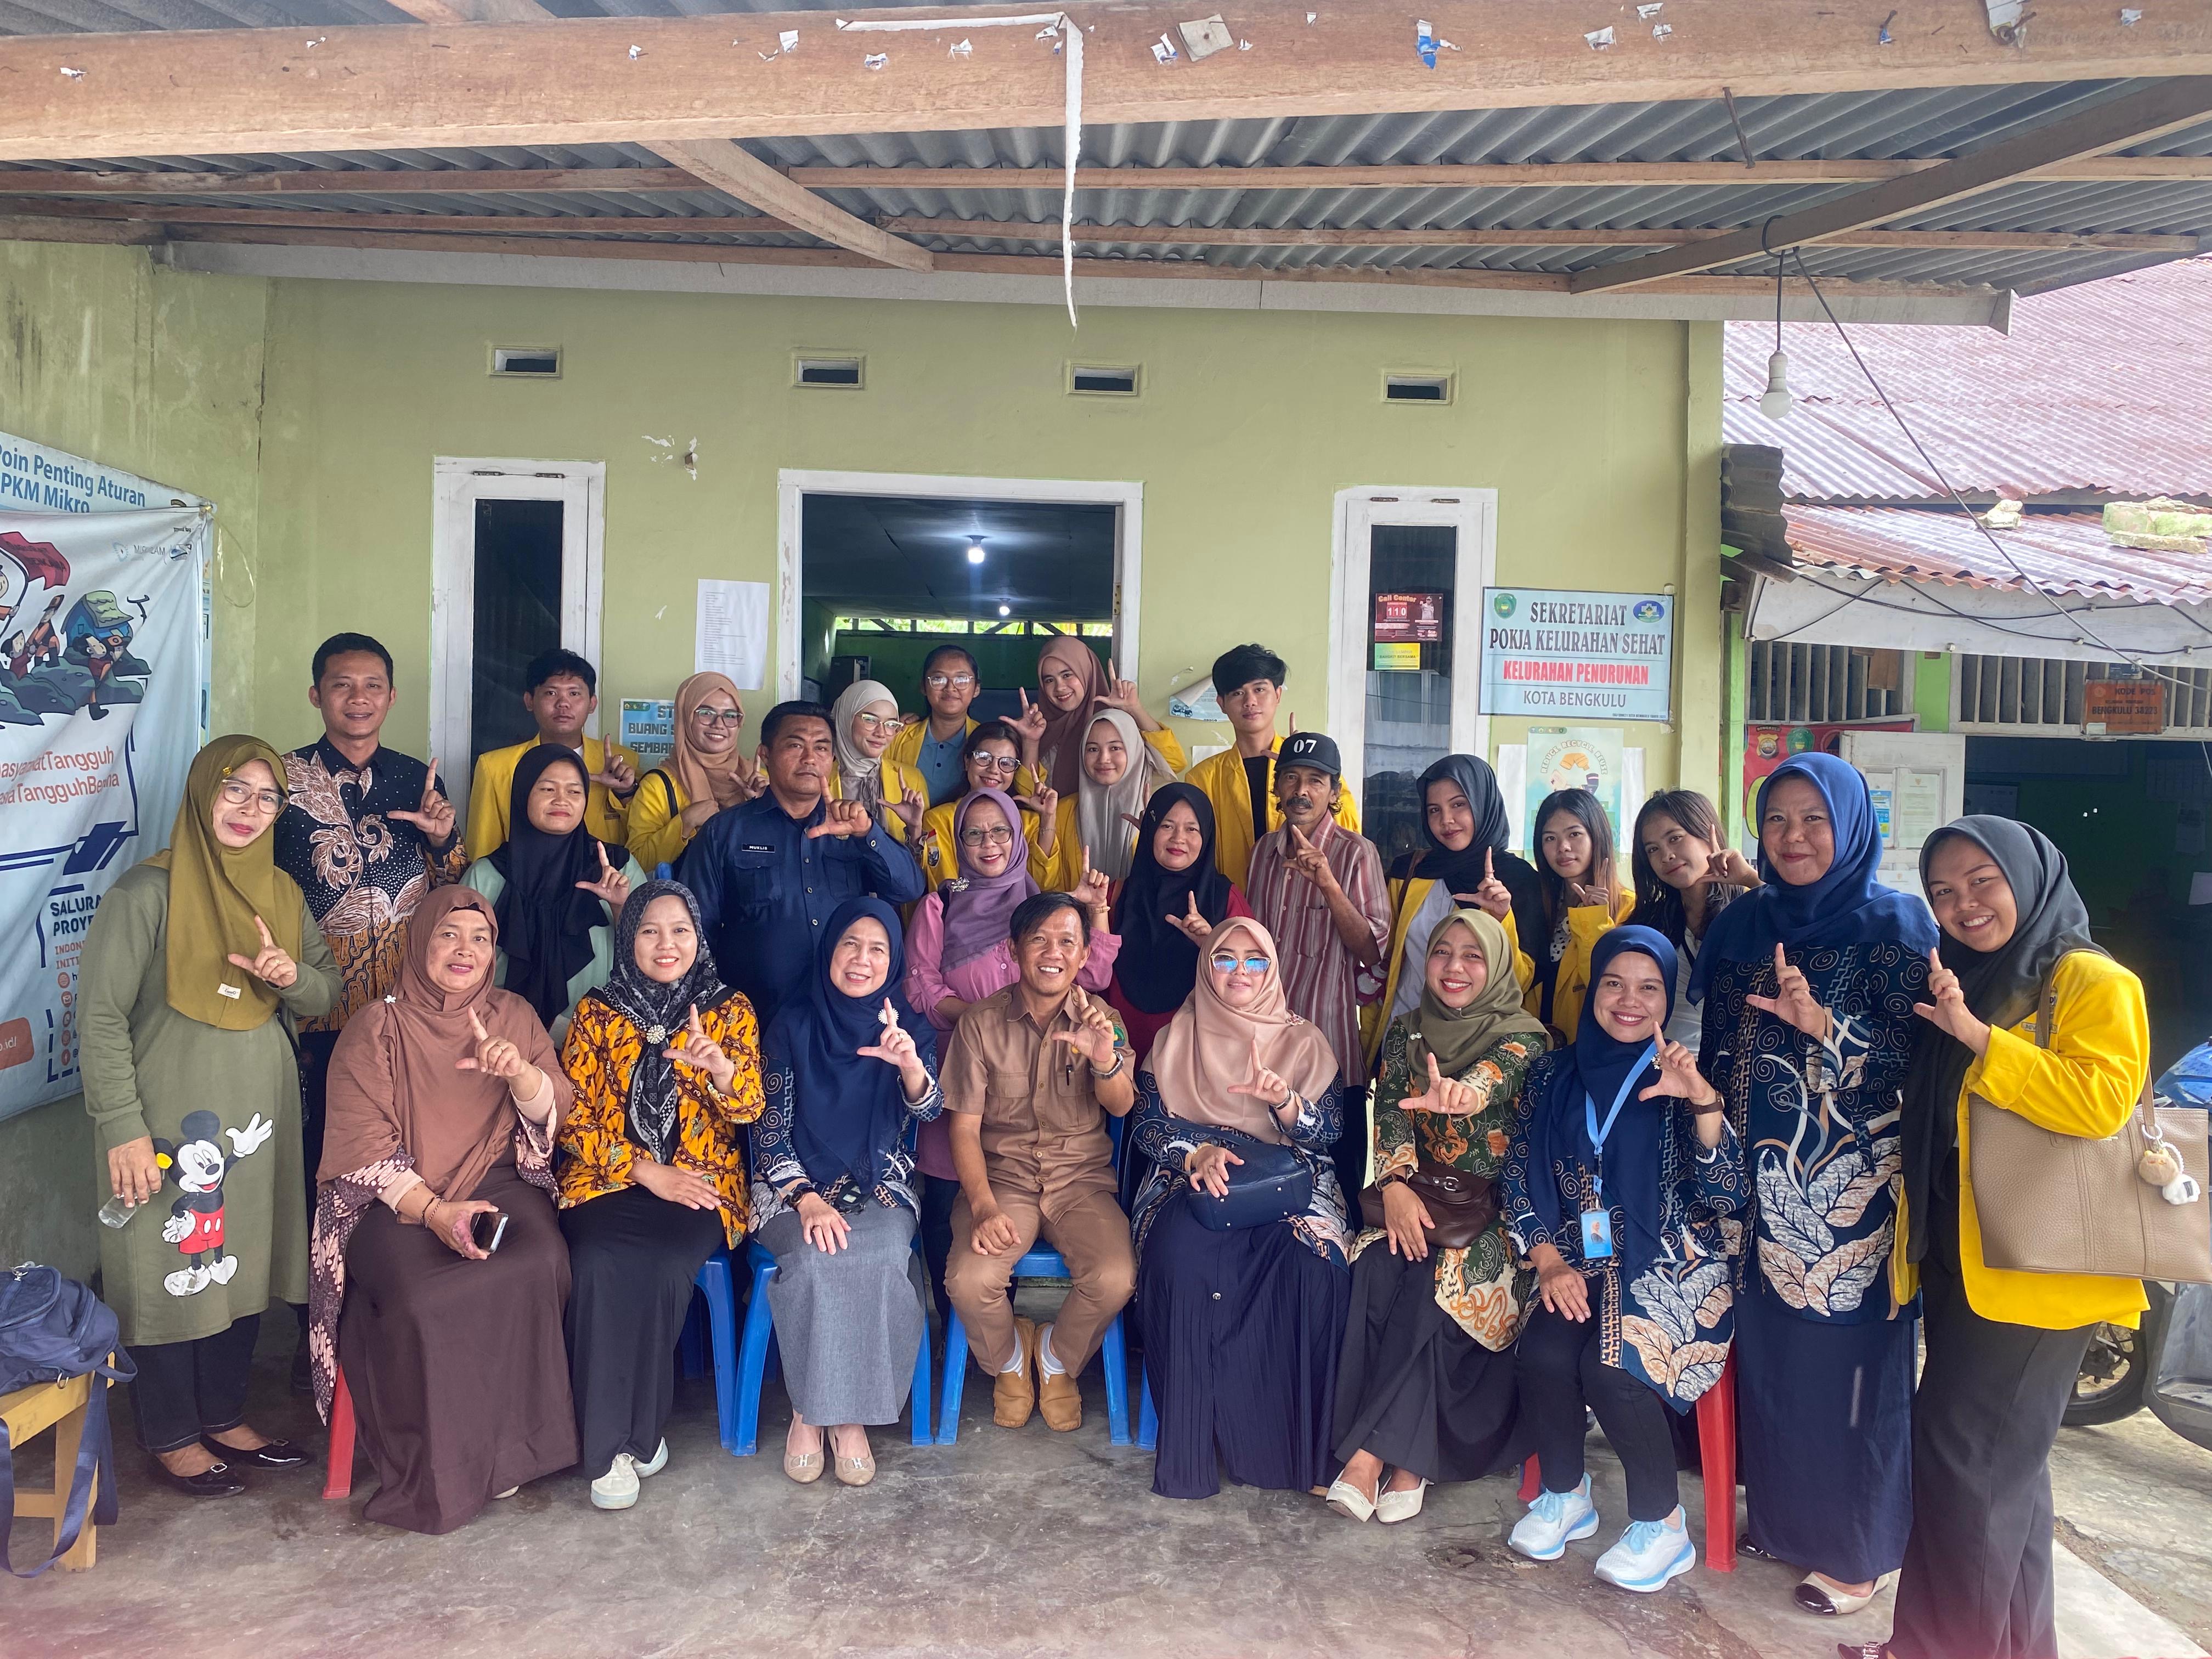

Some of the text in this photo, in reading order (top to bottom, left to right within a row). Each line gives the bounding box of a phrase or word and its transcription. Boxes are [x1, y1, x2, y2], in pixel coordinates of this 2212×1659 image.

[34, 455, 94, 496] Penting
[98, 476, 145, 507] Aturan
[1, 472, 90, 512] PKM Mikro
[1393, 594, 1417, 603] Center
[1387, 607, 1406, 616] 110
[1530, 602, 1627, 627] SEKRETARIAT
[1489, 628, 1665, 655] POKJA KELURAHAN SEHAT
[1503, 660, 1649, 685] KELURAHAN PENURUNAN
[1523, 690, 1626, 708] KOTA BENGKULU
[2092, 706, 2158, 714] BENGKULU 38223
[629, 723, 667, 735] BUANG
[1293, 739, 1317, 753] 07
[1594, 751, 1609, 775] REUSE
[55, 940, 85, 955] INDON
